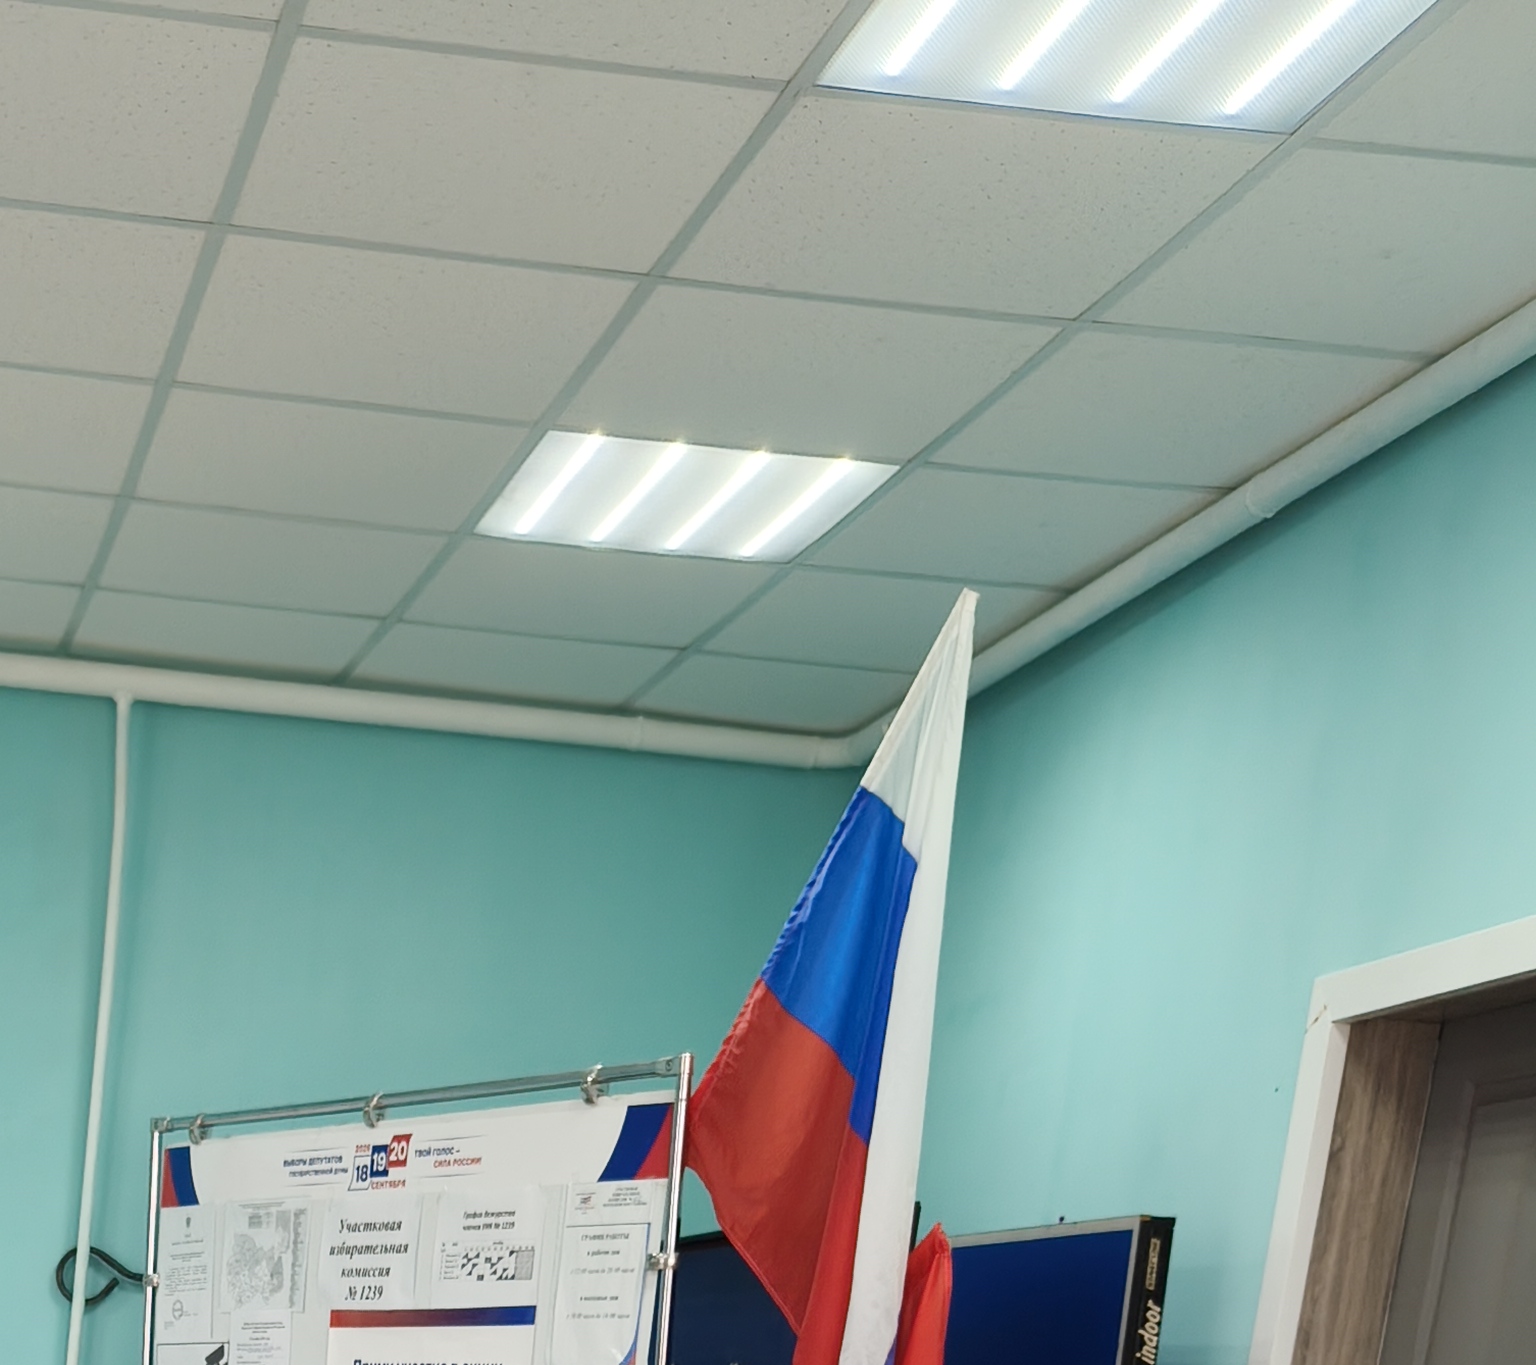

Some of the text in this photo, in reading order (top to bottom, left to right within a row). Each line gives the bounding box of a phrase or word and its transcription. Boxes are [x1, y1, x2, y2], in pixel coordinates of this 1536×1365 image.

[432, 1146, 455, 1157] ГОЛОС
[355, 1141, 408, 1183] 18 19 20
[433, 1159, 451, 1168] СИЛА
[371, 1179, 406, 1190] СЕНТЯБРЯ
[338, 1218, 403, 1234] Участковая
[501, 1221, 515, 1230] 1239
[328, 1242, 409, 1260] избирательная
[340, 1265, 392, 1279] комиссия
[344, 1285, 384, 1301] № 1239
[1135, 1299, 1162, 1365] indoor
